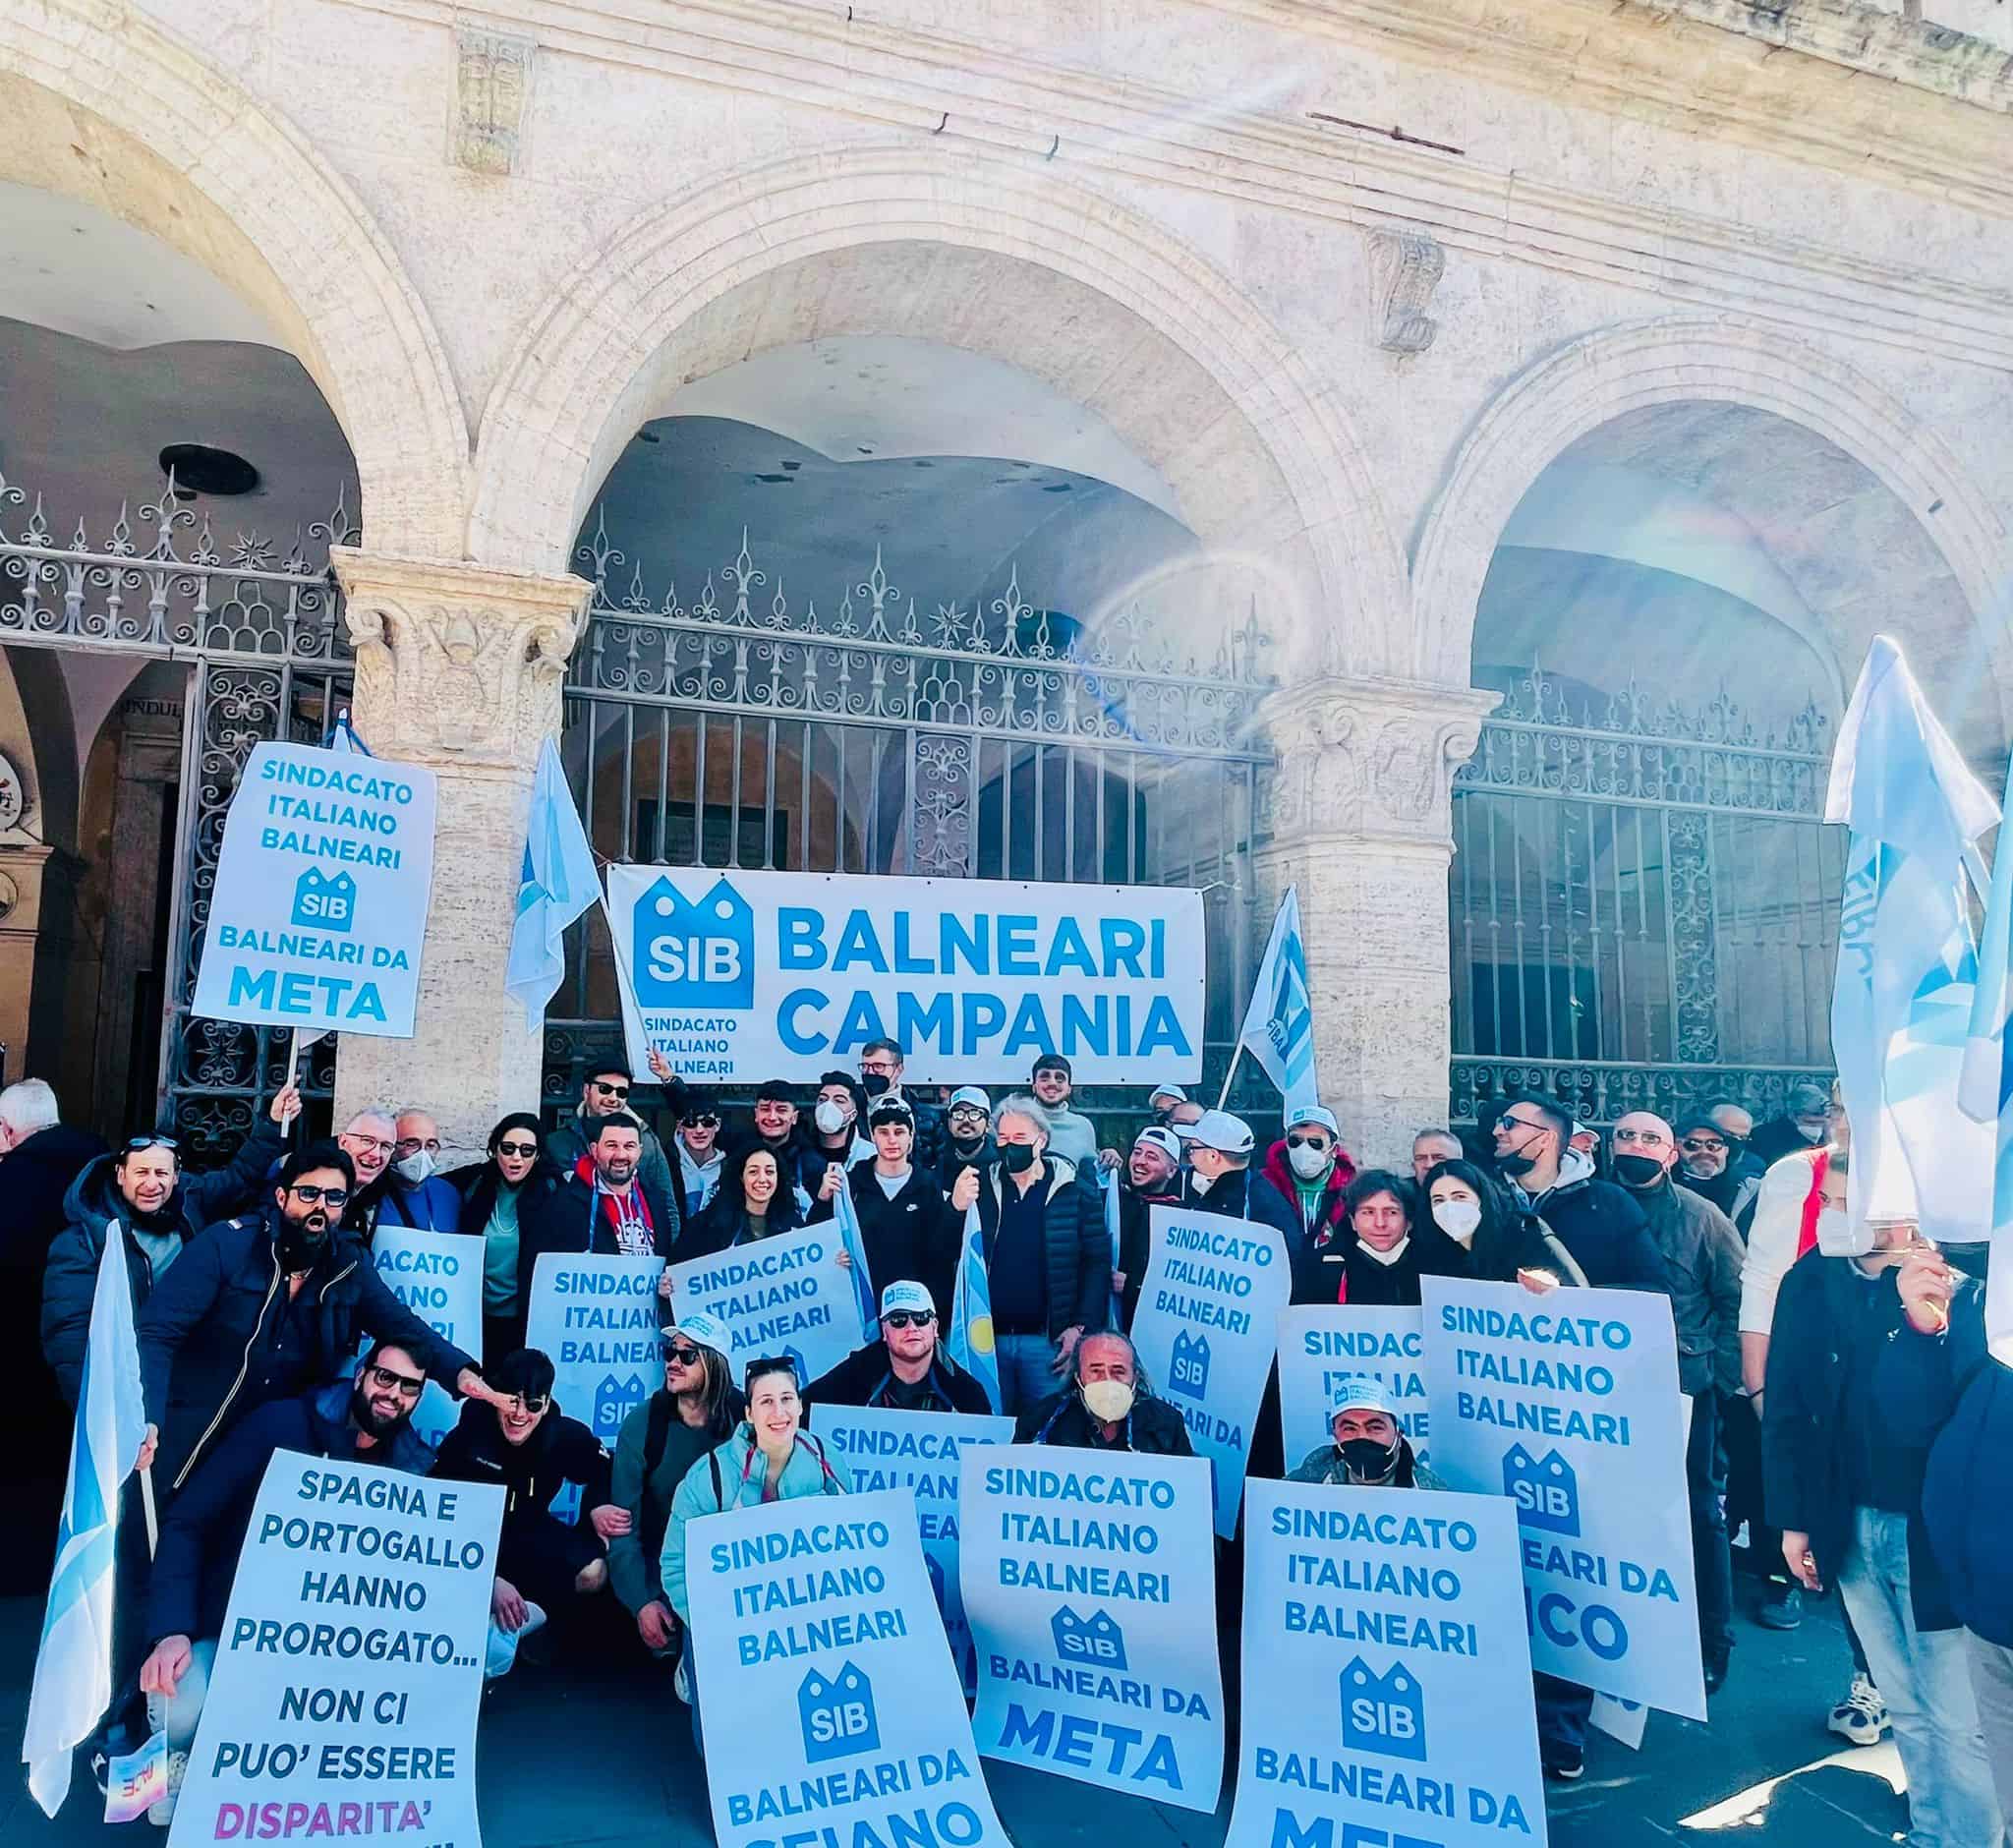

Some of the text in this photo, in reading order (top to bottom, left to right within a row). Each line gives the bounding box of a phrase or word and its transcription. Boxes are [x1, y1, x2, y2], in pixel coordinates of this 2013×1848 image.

[260, 760, 412, 804] SINDACATO
[268, 794, 396, 835] ITALIANO
[260, 828, 401, 869] BALNEARI
[300, 894, 347, 919] SIB
[219, 925, 409, 970] BALNEARI DA
[648, 936, 741, 983] SIB
[778, 906, 1166, 979] BALNEARI
[228, 965, 387, 1021] META
[645, 1018, 736, 1032] SINDACATO
[776, 988, 1192, 1057] CAMPANIA
[653, 1039, 728, 1053] ITALIANO
[668, 1061, 733, 1074] LNEARI
[376, 1249, 459, 1276] ACATO
[1166, 1226, 1273, 1267] SINDACATO
[554, 1272, 661, 1296] SINDACA
[688, 1242, 824, 1296] SINDACATO
[1165, 1258, 1251, 1298] ITALIANO
[564, 1306, 663, 1330] ITALIAN
[731, 1303, 832, 1352] ALNEARI
[1156, 1290, 1250, 1335] BALNEARI
[1441, 1304, 1632, 1351] SINDACATO
[560, 1341, 665, 1363] BALNEA
[1304, 1331, 1422, 1357] SINDAC
[1174, 1357, 1204, 1386] SIB
[1456, 1350, 1614, 1396] ITALIANO
[1215, 1419, 1242, 1450] DA
[1457, 1392, 1630, 1447] BALNEARI
[832, 1427, 960, 1461] SINDACA
[297, 1470, 458, 1521] SPAGNA E
[852, 1469, 958, 1500] TALIAN
[986, 1469, 1175, 1509] SINDACATO
[1514, 1478, 1571, 1518] SIB
[259, 1514, 484, 1570] PORTOGALLO
[711, 1521, 890, 1573] SINDACATO
[1002, 1513, 1158, 1554] ITALIANO
[1272, 1506, 1477, 1552] SINDACATO
[301, 1571, 427, 1612] HANNO
[733, 1565, 885, 1617] ITALIANO
[1000, 1558, 1170, 1603] BALNEARI
[1288, 1554, 1461, 1601] ITALIANO
[1524, 1538, 1679, 1603] EARI DA
[230, 1618, 478, 1668] PROROGATO...
[738, 1608, 907, 1666] BALNEARI
[1063, 1633, 1117, 1659] SIB
[1285, 1601, 1478, 1656] BALNEARI
[1525, 1587, 1629, 1661] ICO
[279, 1687, 408, 1725] NON CI
[989, 1654, 1211, 1721] BALNEARI DA
[810, 1702, 869, 1742] SIB
[1352, 1699, 1416, 1739] SIB
[211, 1742, 456, 1780] PUO' ESSERE
[998, 1703, 1183, 1791] META
[727, 1748, 970, 1826] BALNEARI DA
[1255, 1747, 1531, 1834] BALNEARI DA
[214, 1800, 431, 1840] DISPARITA'
[743, 1802, 984, 1848] ANO
